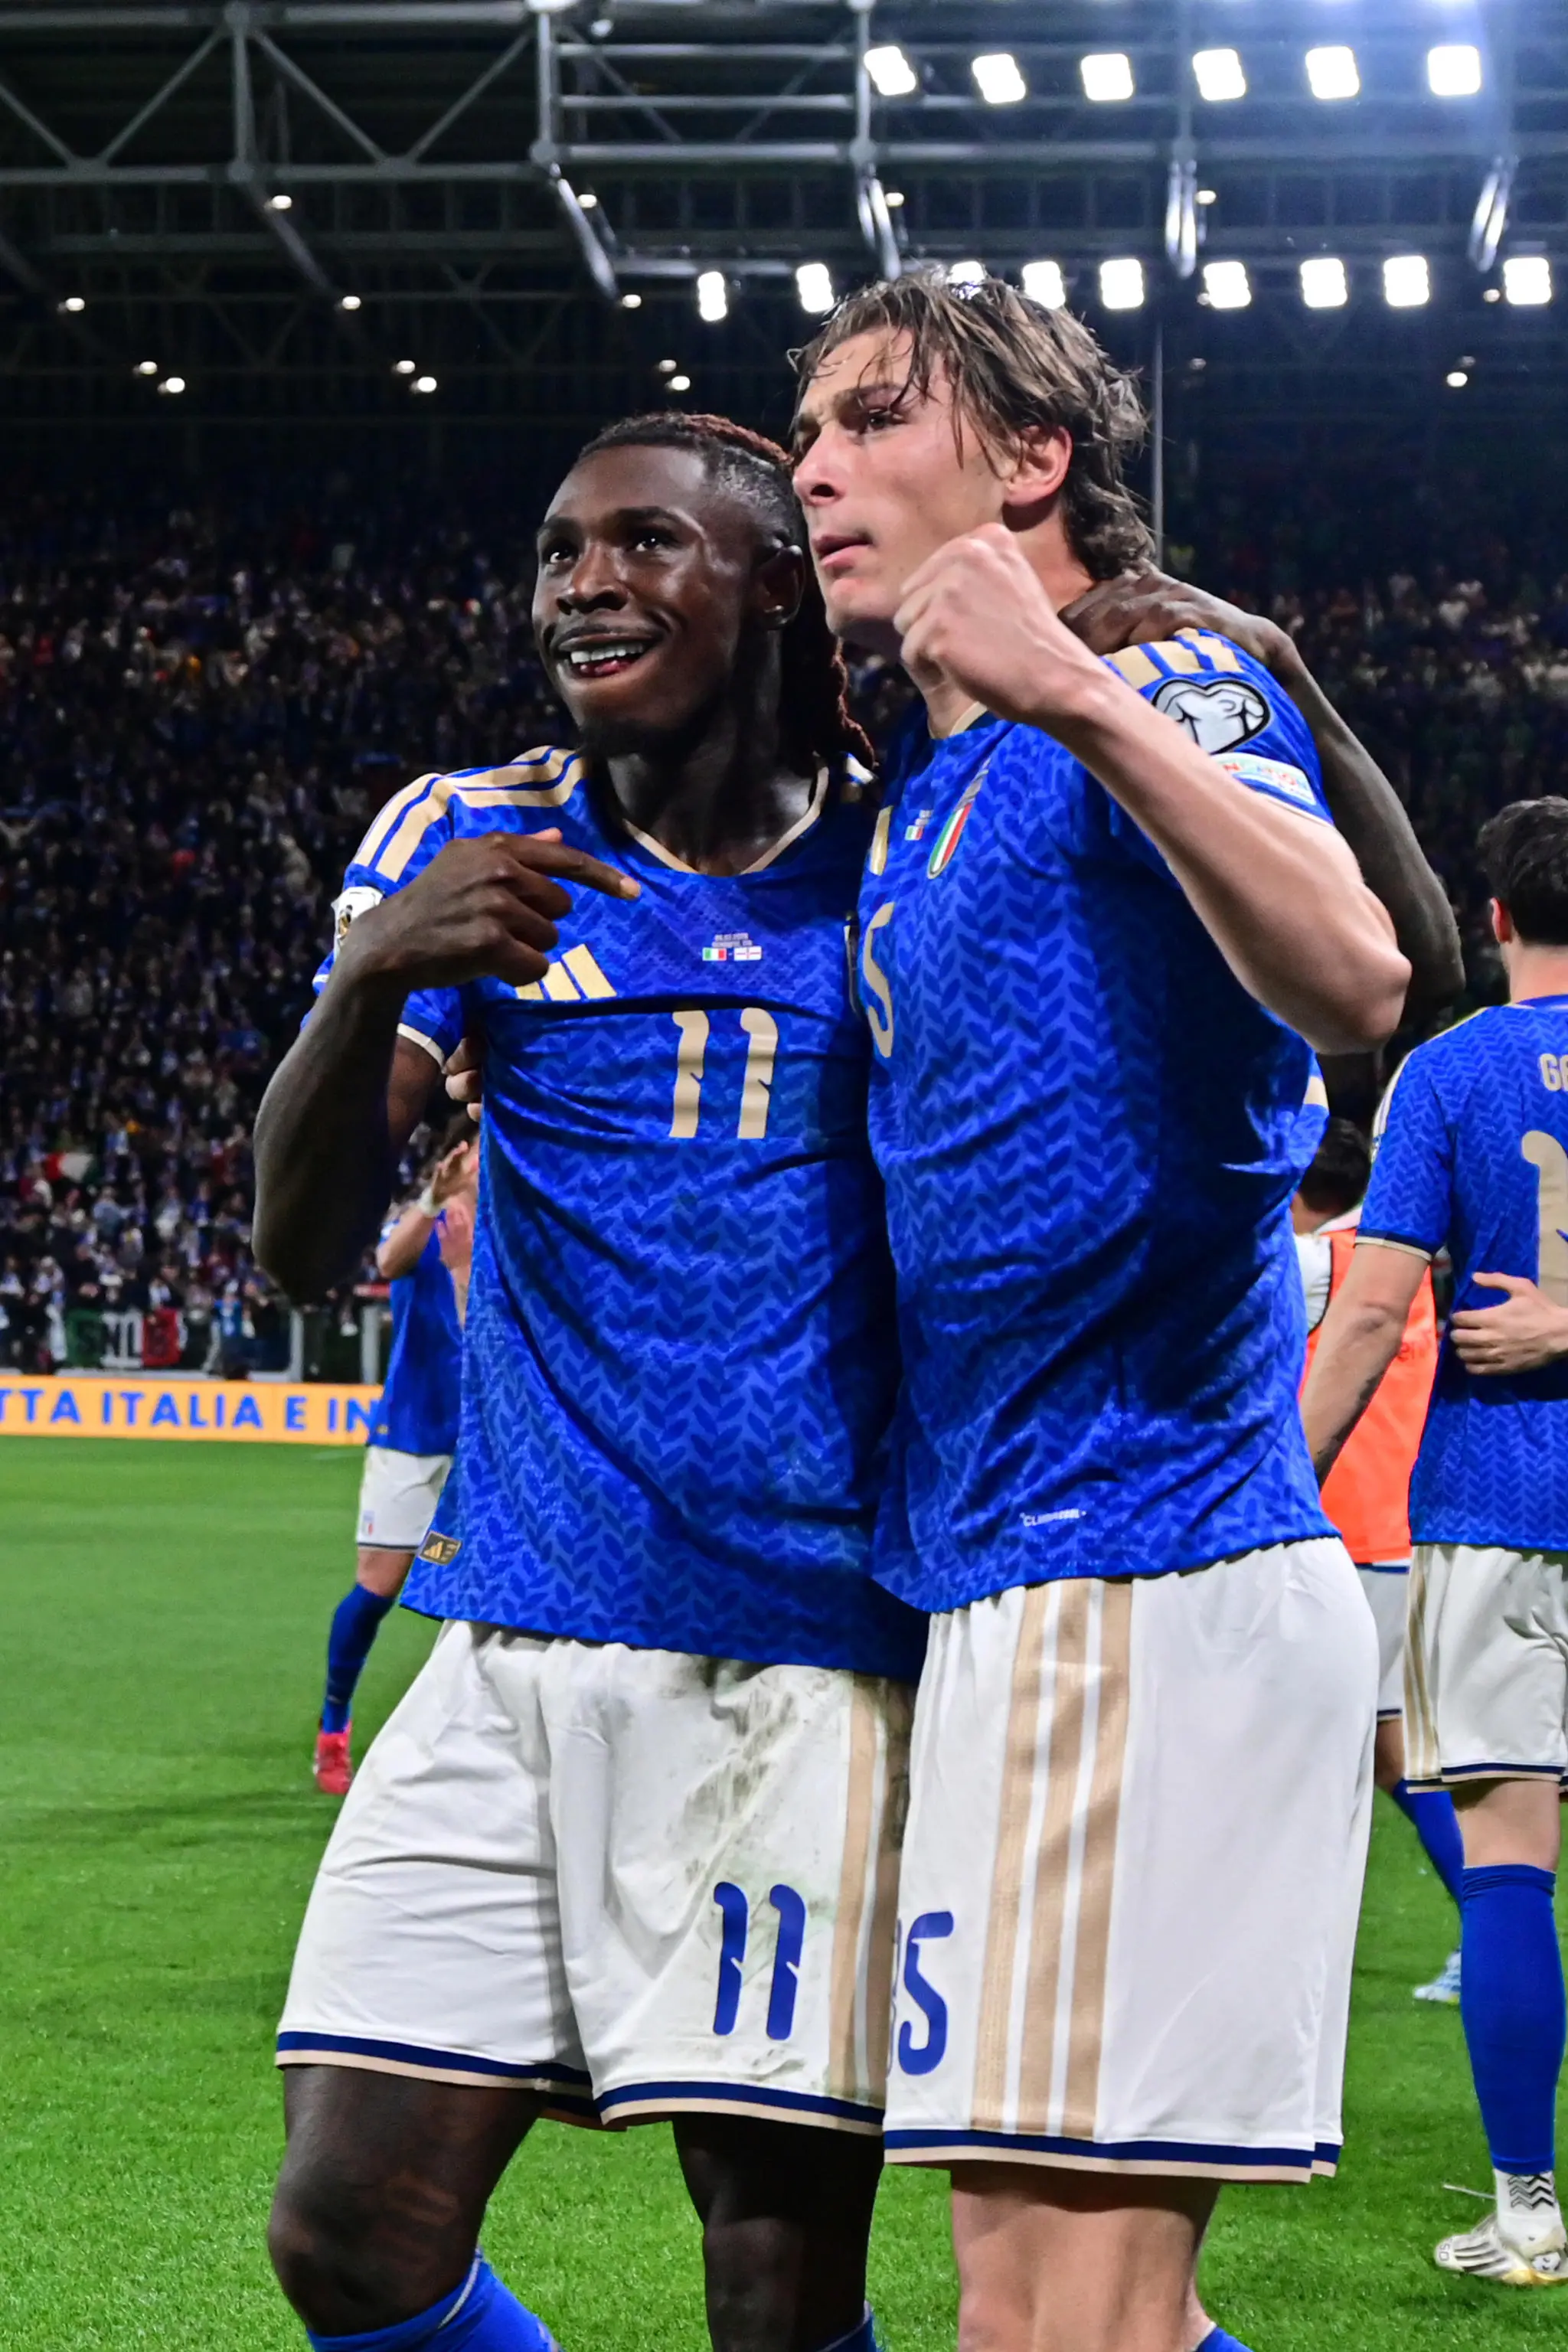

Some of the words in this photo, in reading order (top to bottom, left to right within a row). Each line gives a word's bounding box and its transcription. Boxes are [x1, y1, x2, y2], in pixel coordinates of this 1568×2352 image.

[668, 1007, 779, 1139] 11
[102, 1390, 263, 1430] ITALIA
[285, 1395, 307, 1431] E
[328, 1397, 381, 1433] IN
[713, 1881, 806, 2041] 11
[887, 1911, 954, 2076] 5
